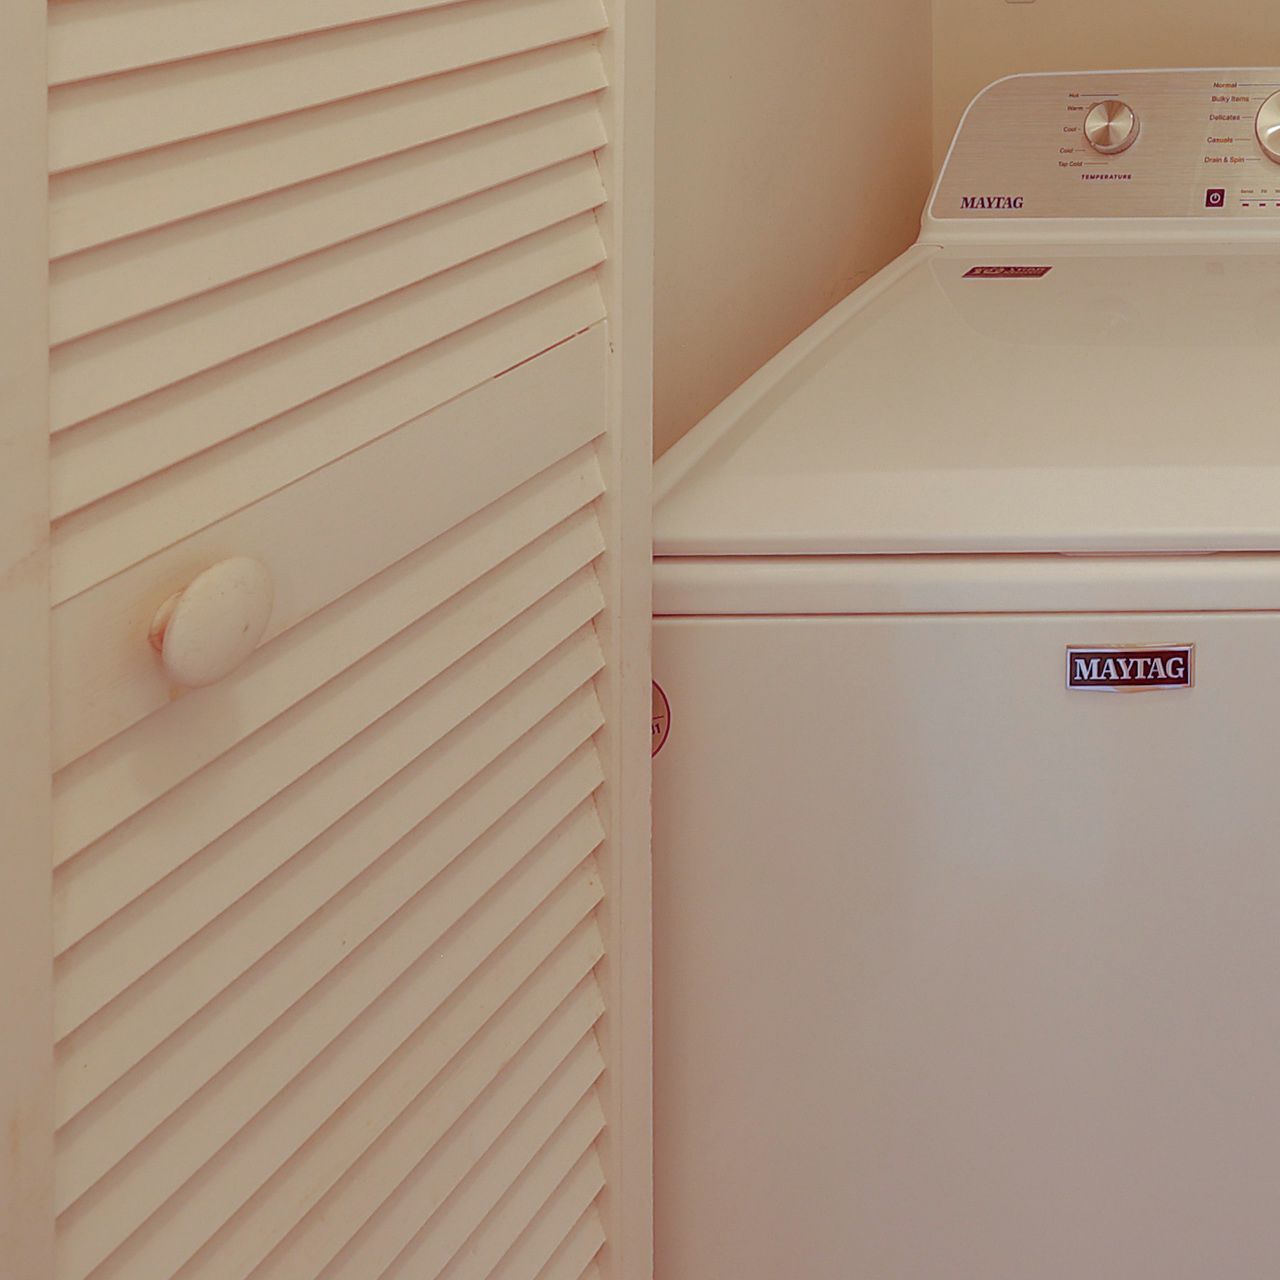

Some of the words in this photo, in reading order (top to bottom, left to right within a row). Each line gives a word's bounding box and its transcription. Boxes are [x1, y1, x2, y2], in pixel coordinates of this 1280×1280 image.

[1211, 95, 1231, 103] Bulky
[1229, 156, 1245, 165] Spin
[960, 196, 1024, 210] MAYTAG
[1073, 656, 1186, 680] MAYTAG
